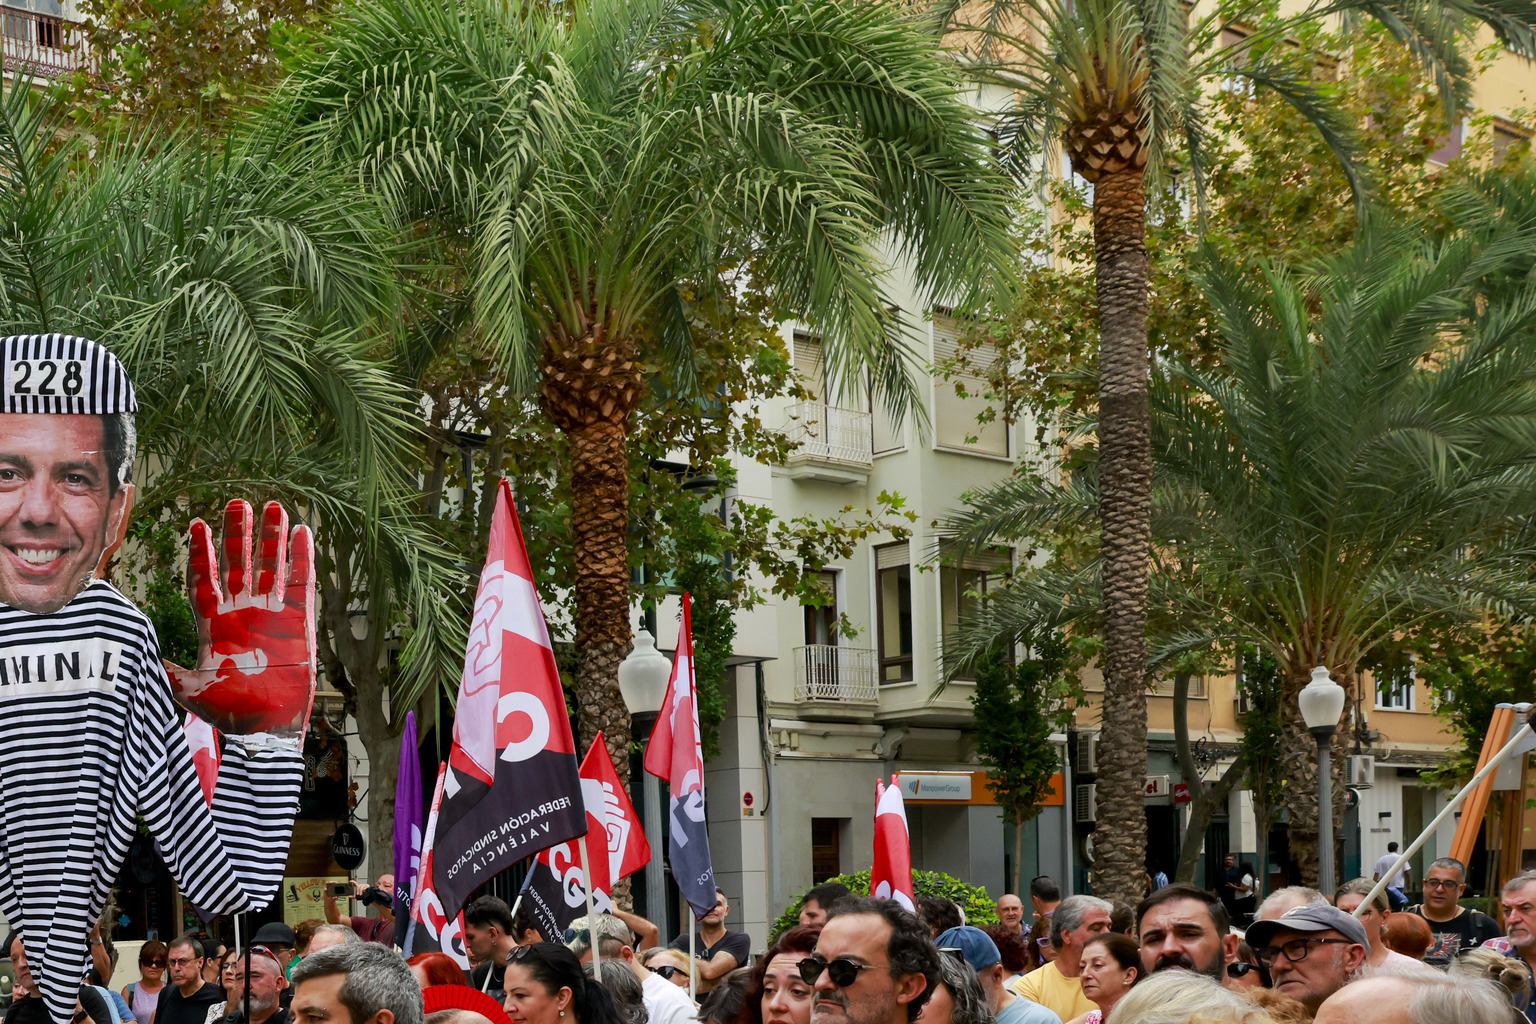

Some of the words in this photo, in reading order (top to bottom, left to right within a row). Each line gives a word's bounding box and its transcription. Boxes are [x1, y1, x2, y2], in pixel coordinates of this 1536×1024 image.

[14, 360, 83, 396] 228
[920, 783, 961, 794] ManpowerGroup
[333, 844, 361, 857] GUINNESS
